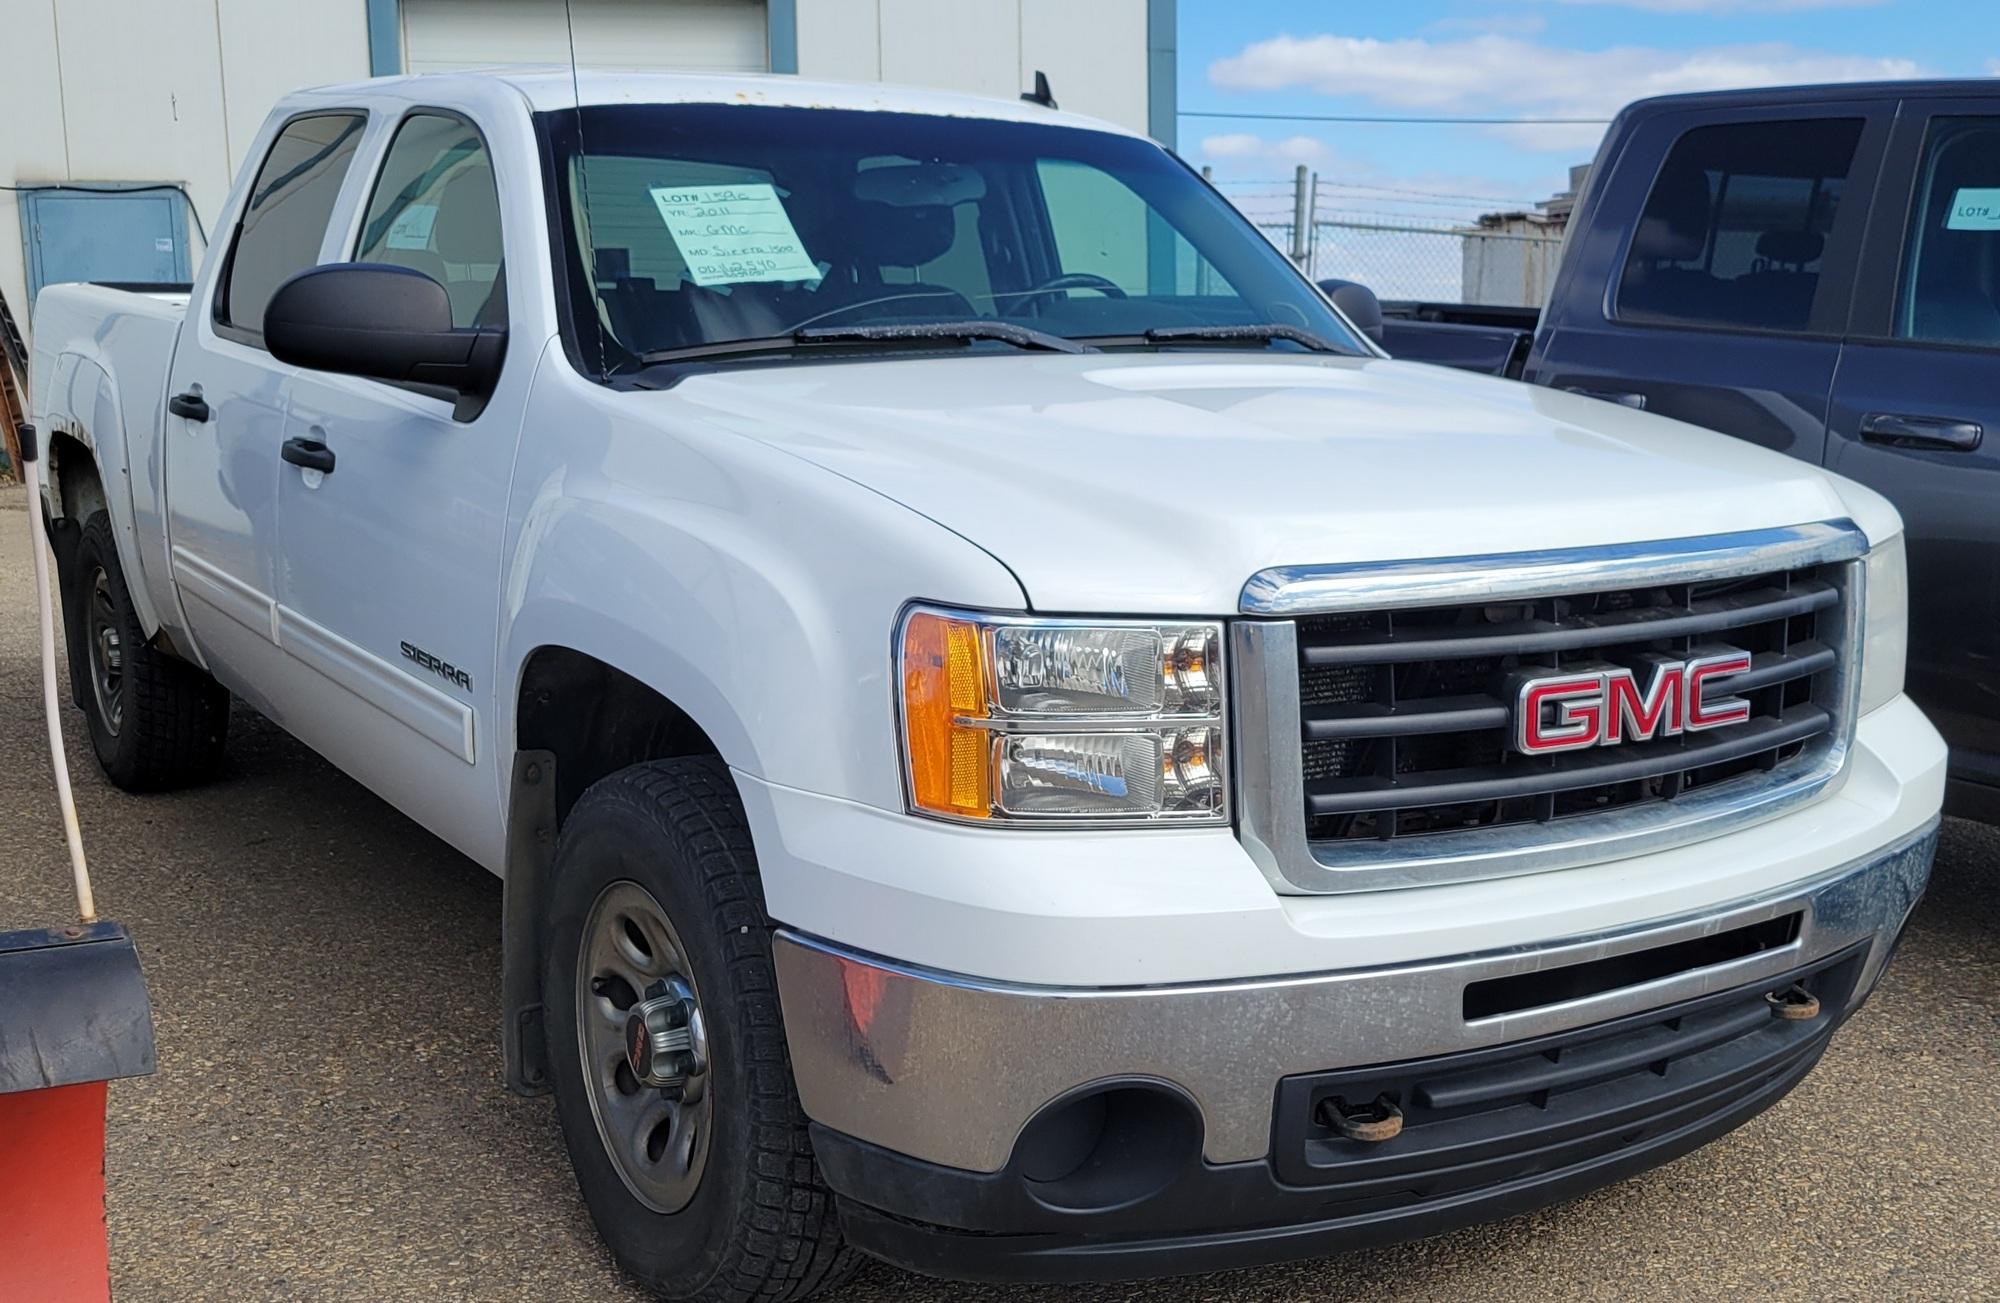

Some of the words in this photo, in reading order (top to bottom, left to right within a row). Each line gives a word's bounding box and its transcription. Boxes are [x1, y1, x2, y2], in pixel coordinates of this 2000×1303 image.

[694, 207, 730, 217] 2011
[706, 224, 751, 236] GMC
[400, 640, 474, 694] SIERRA
[1517, 651, 1751, 756] GMC
[632, 1022, 646, 1072] GMC
